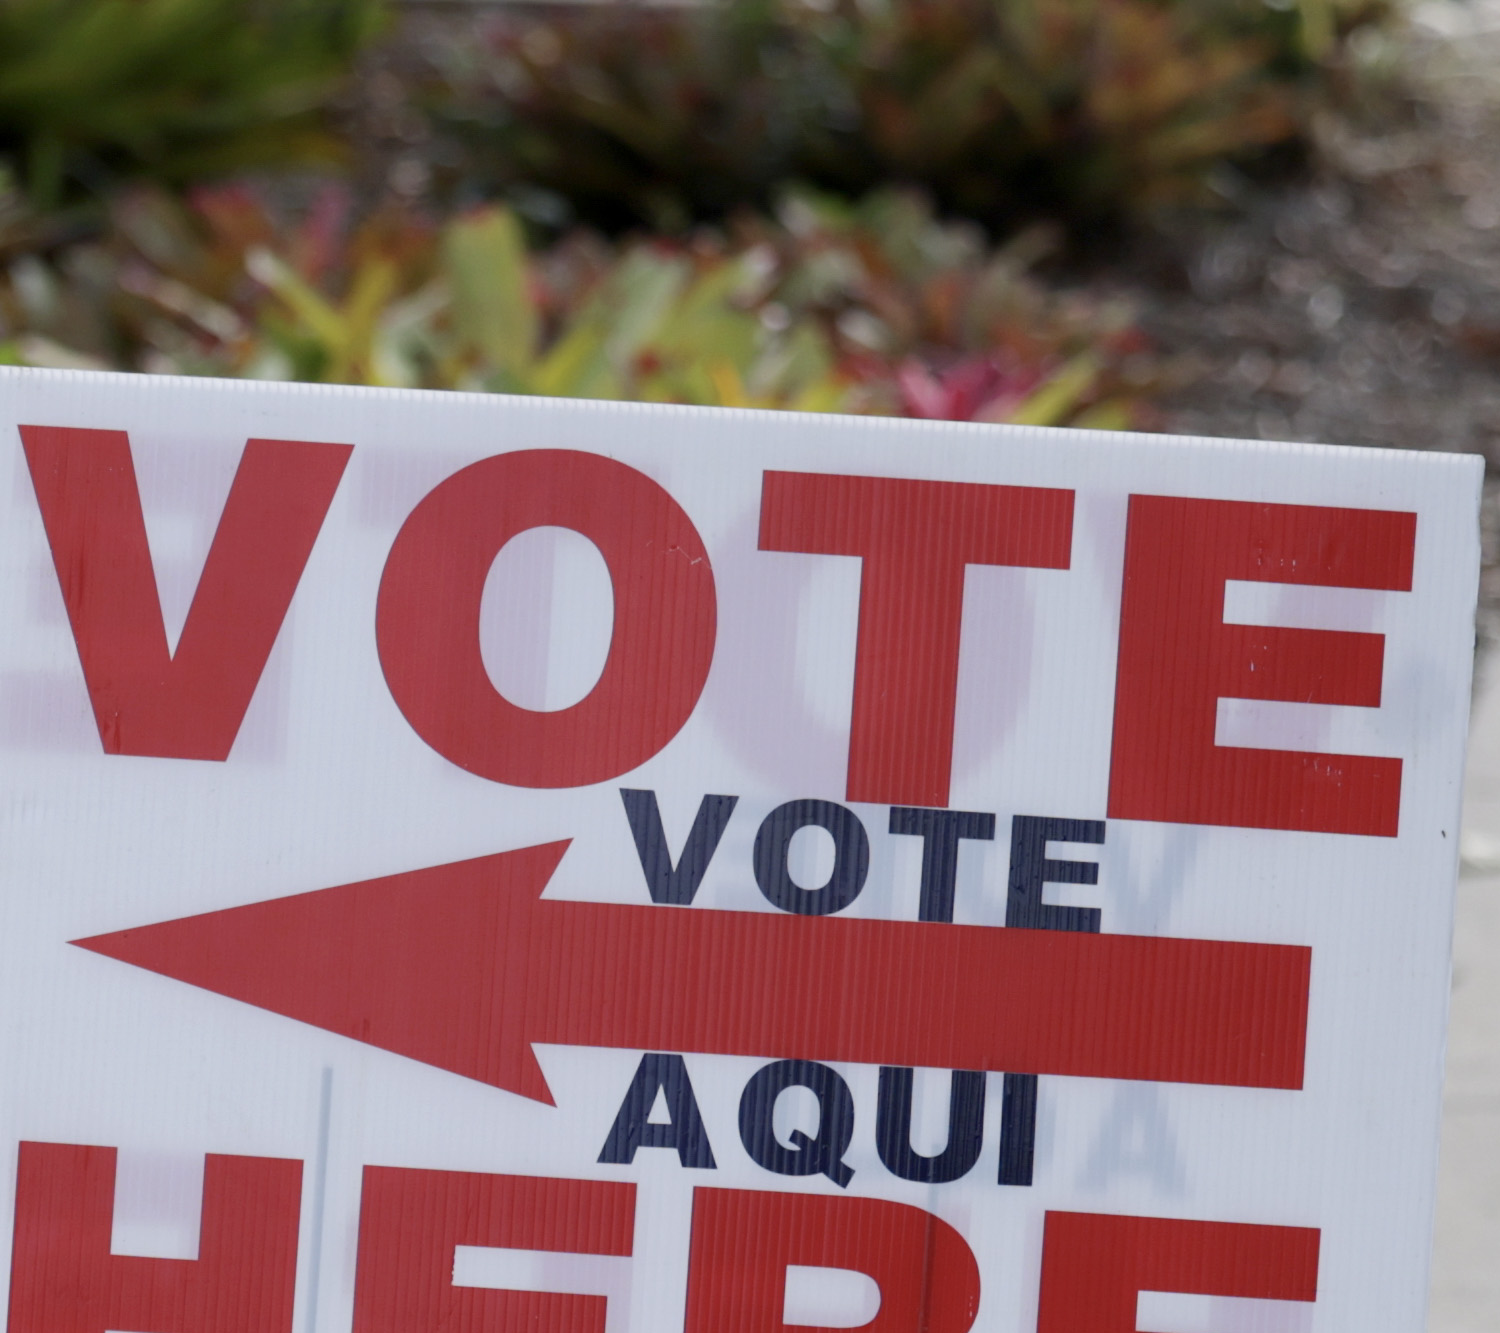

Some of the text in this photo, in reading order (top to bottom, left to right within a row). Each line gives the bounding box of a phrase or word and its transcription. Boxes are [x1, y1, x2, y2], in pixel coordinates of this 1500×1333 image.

[19, 424, 1418, 838] VOTE
[618, 787, 1106, 935] VOTE
[596, 1052, 1039, 1189] AQUI
